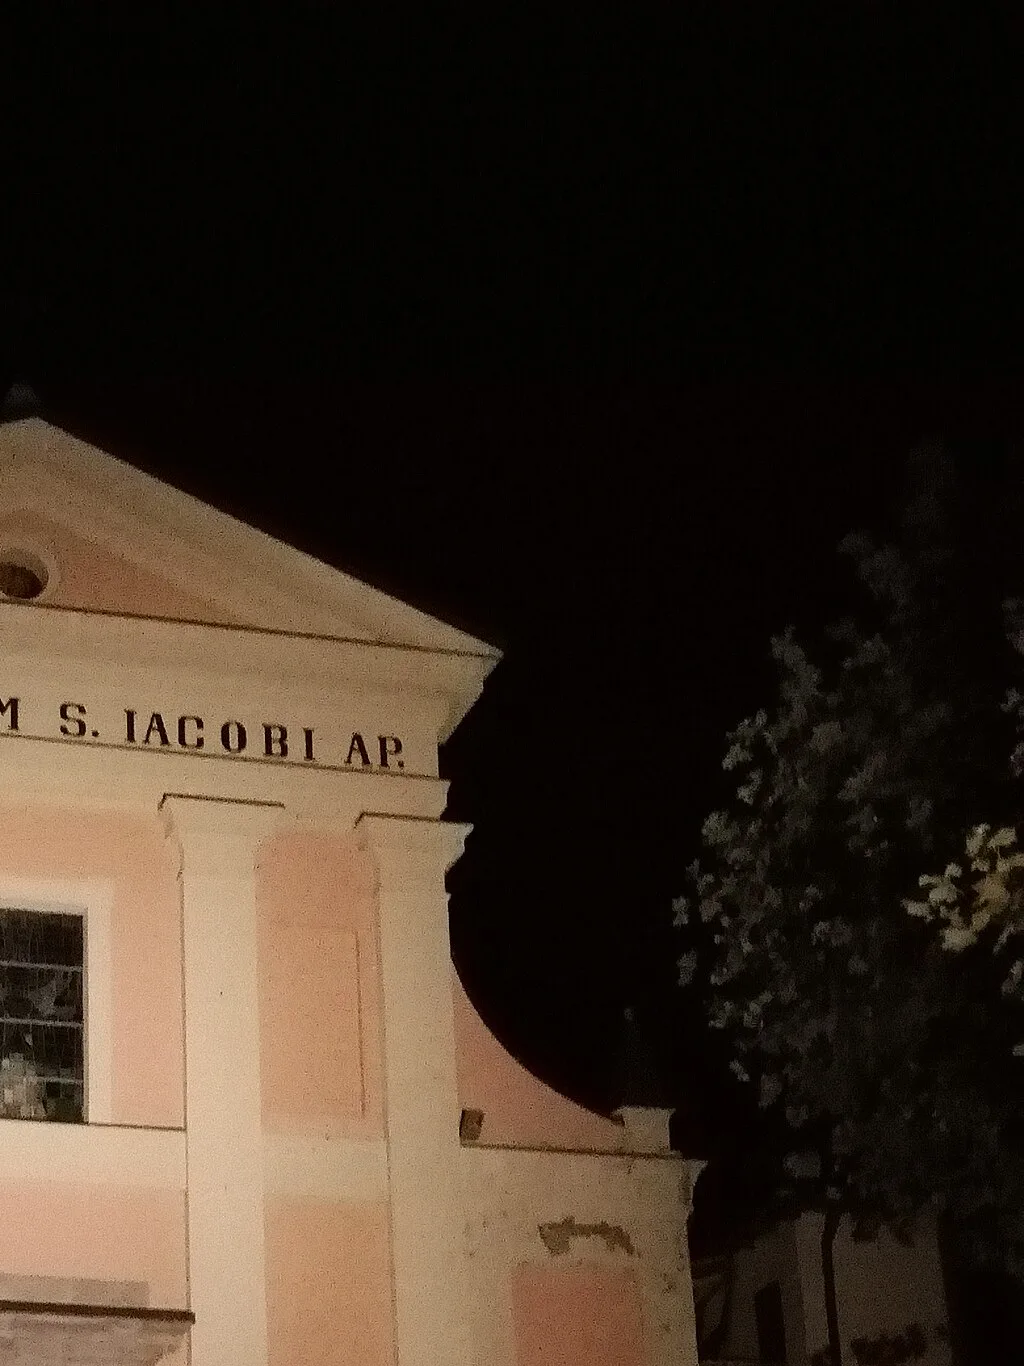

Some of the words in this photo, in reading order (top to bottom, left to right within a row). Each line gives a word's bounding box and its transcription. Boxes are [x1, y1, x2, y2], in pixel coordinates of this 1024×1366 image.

[58, 701, 100, 738] S.
[123, 708, 315, 762] IACOBI
[345, 731, 405, 769] AP.
